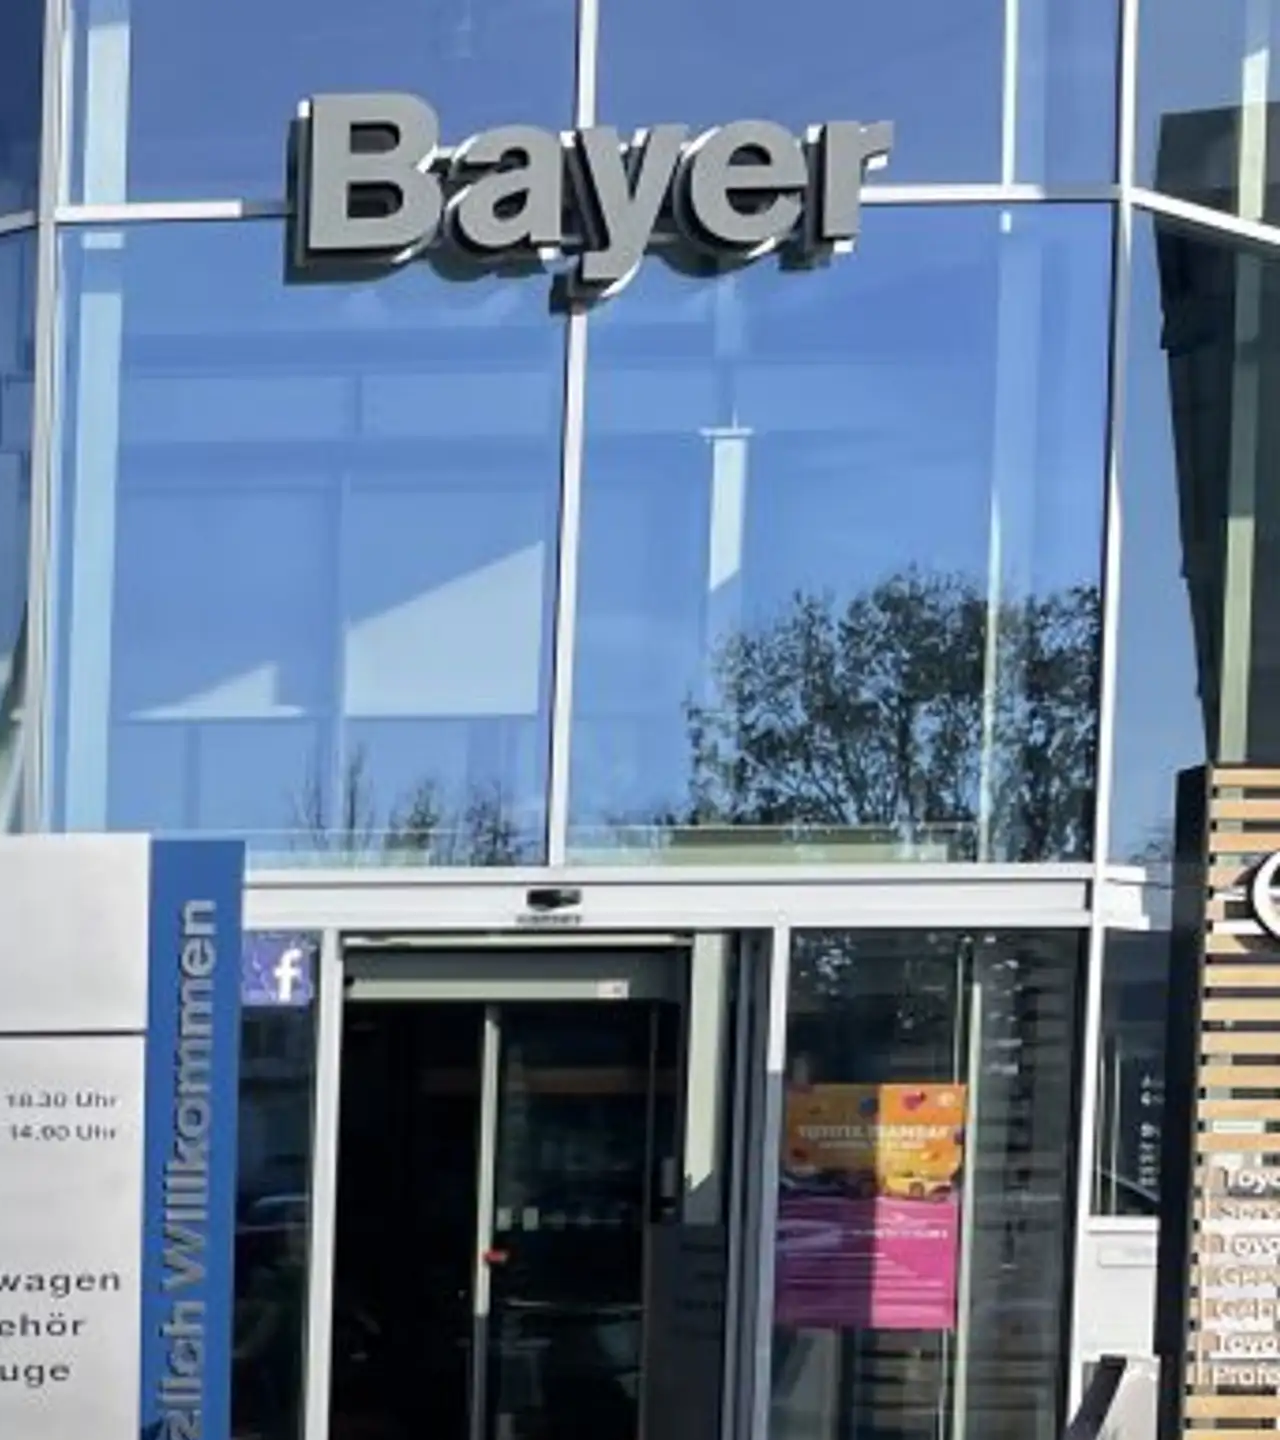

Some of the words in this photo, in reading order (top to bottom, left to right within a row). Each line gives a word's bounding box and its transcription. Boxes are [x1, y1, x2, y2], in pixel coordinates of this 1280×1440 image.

[304, 92, 893, 290] Bayer
[76, 1091, 118, 1108] Uhr
[76, 1124, 117, 1141] Uhr
[162, 899, 217, 1292] Willkommen
